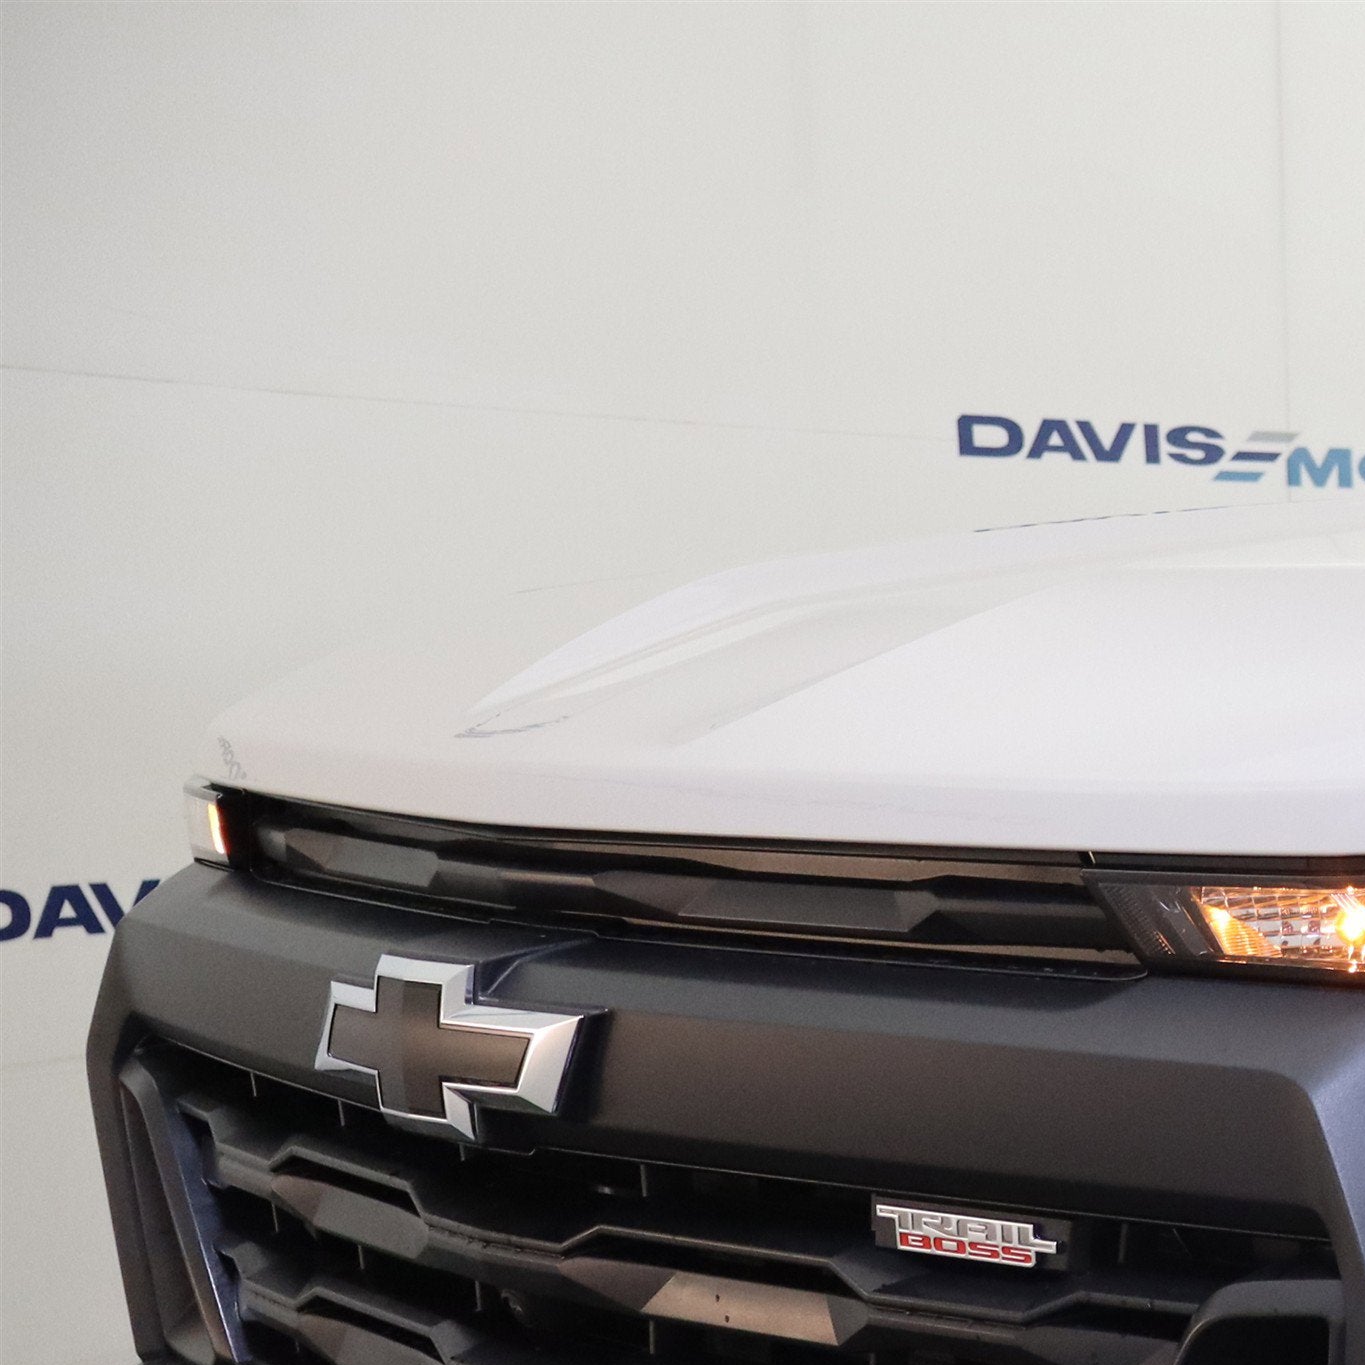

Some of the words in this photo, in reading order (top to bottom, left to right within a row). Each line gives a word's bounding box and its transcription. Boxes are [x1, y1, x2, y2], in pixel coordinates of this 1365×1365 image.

[957, 414, 1226, 466] DAVIS
[875, 1204, 1057, 1254] TRAIL
[898, 1231, 1036, 1268] BOSS
